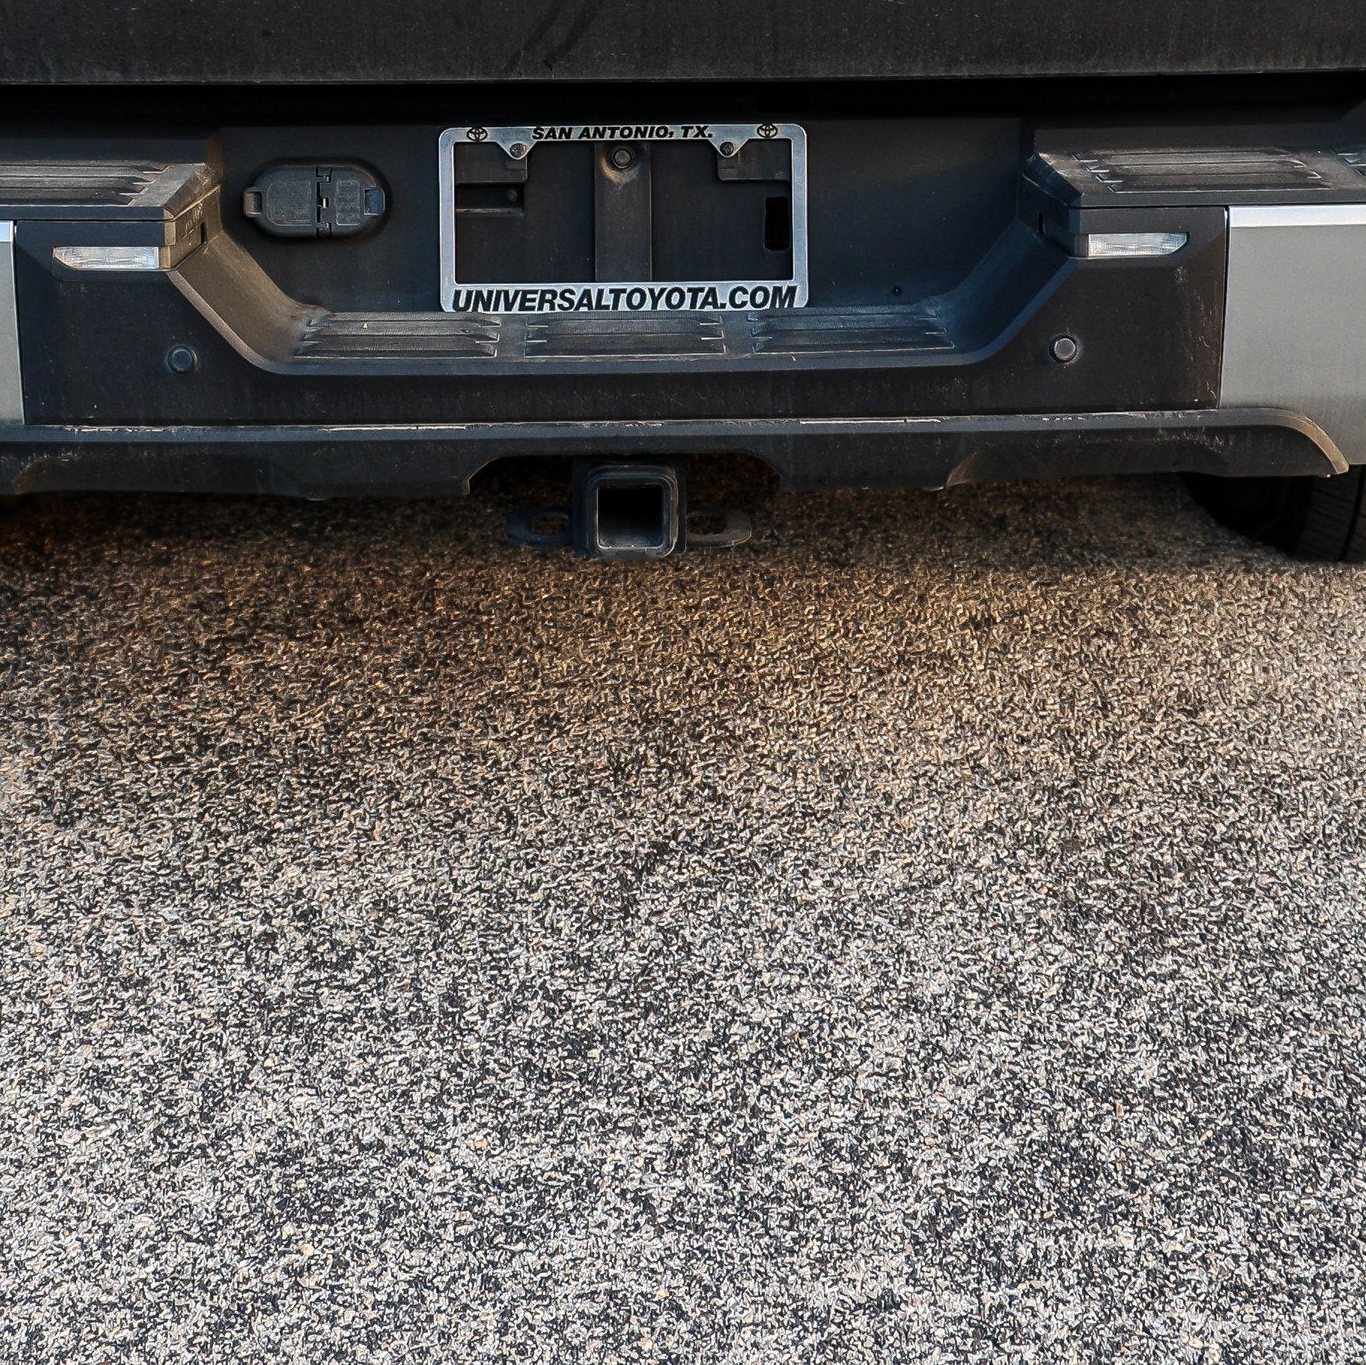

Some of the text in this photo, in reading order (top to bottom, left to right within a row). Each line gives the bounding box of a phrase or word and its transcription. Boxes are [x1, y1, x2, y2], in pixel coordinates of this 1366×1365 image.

[532, 125, 713, 140] SAN ANTONIO, TX.
[452, 285, 798, 312] UNIVERSALTOYOTA.COM
